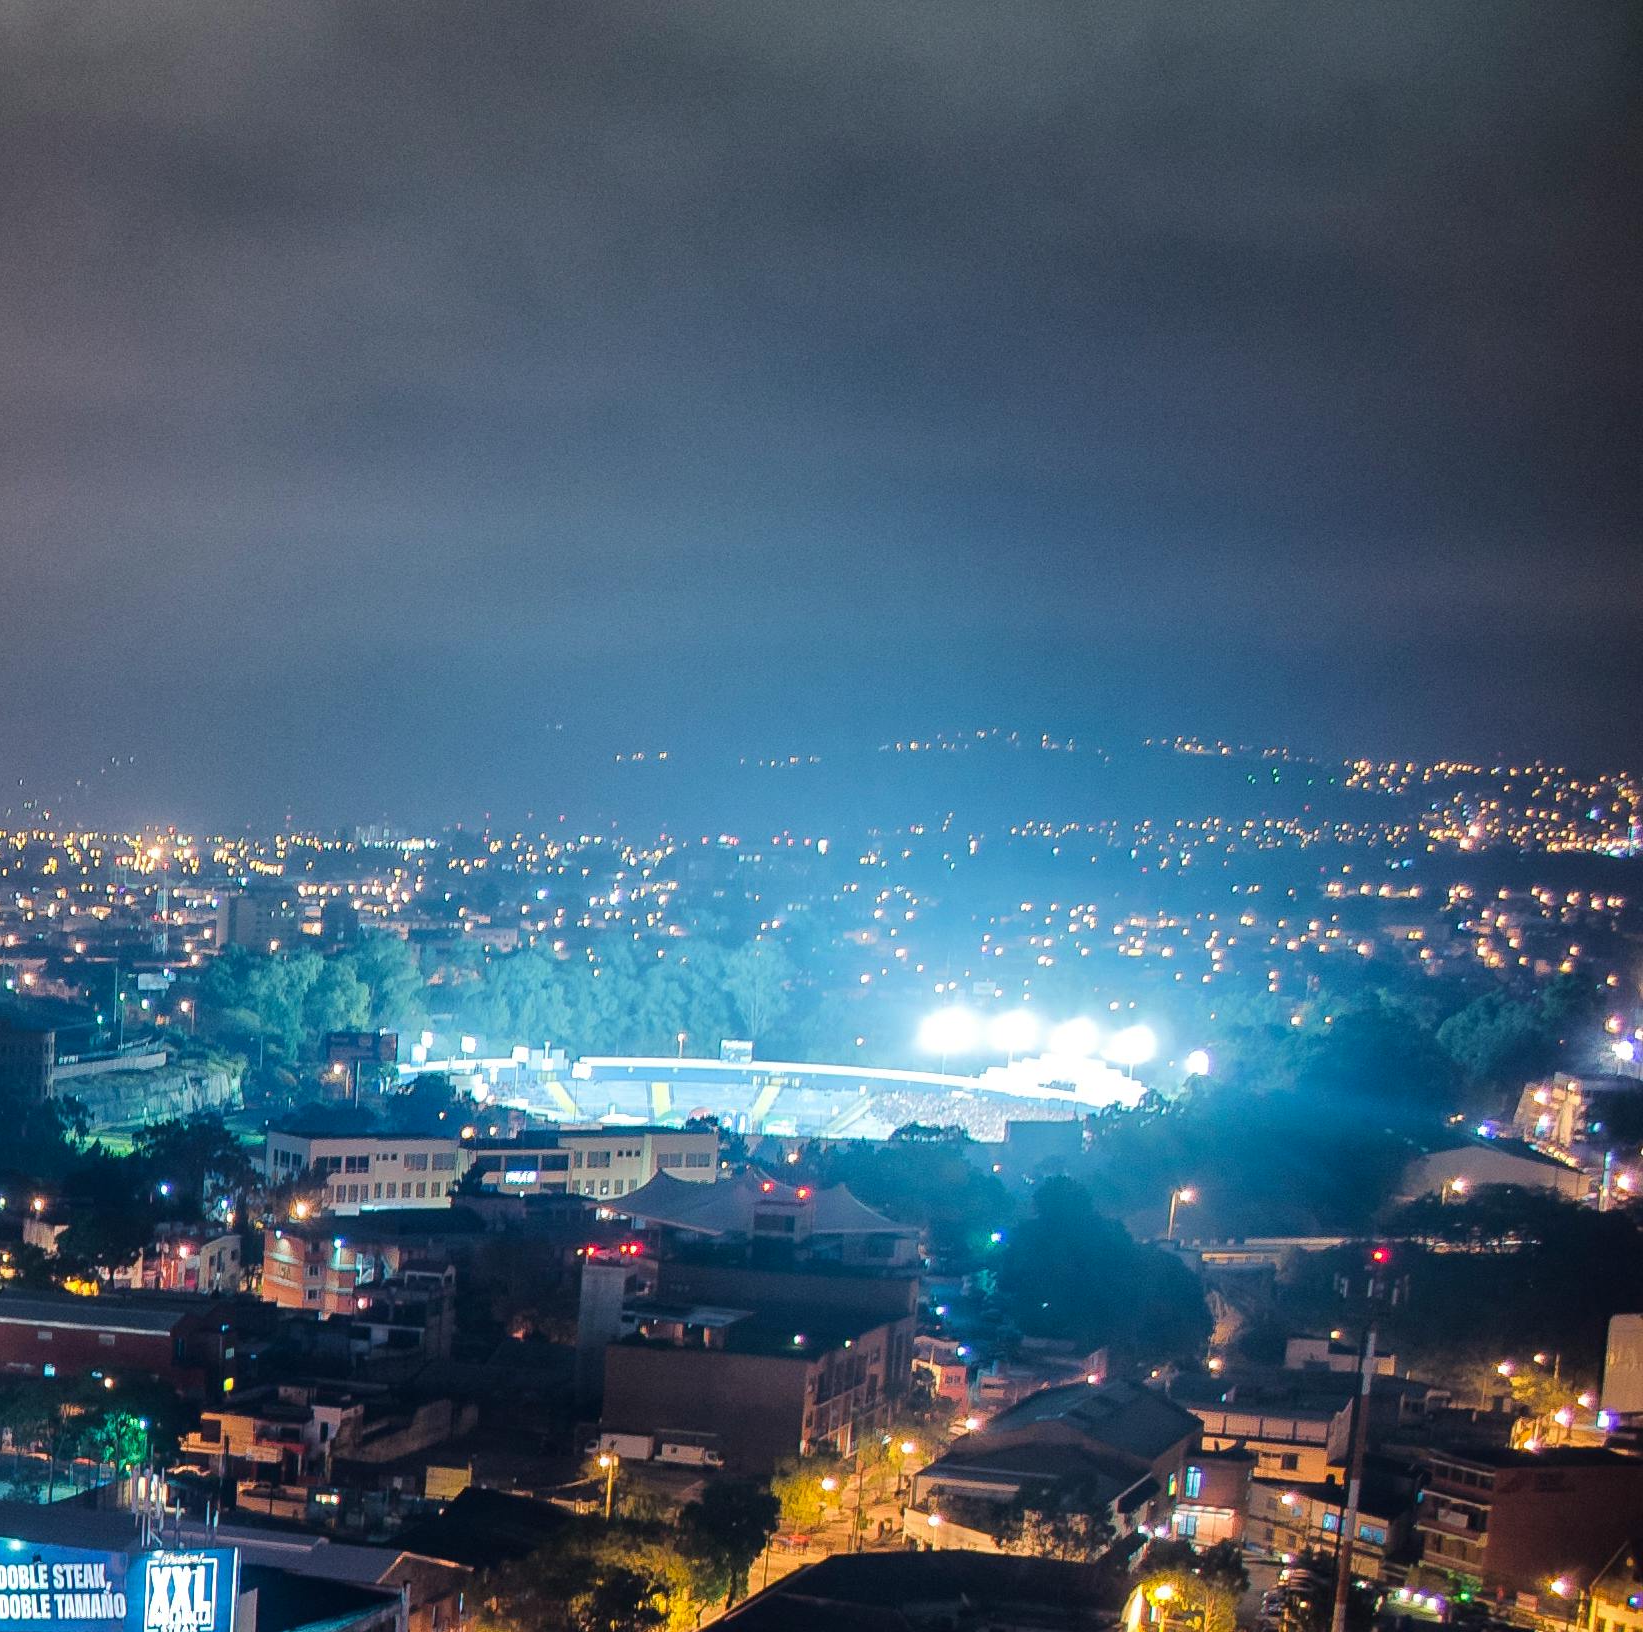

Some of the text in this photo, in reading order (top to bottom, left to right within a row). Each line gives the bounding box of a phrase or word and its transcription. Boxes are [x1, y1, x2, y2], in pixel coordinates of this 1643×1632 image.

[52, 1561, 113, 1594] STEAK,
[149, 1565, 212, 1613] XXL
[53, 1589, 127, 1621] TAMAÑO
